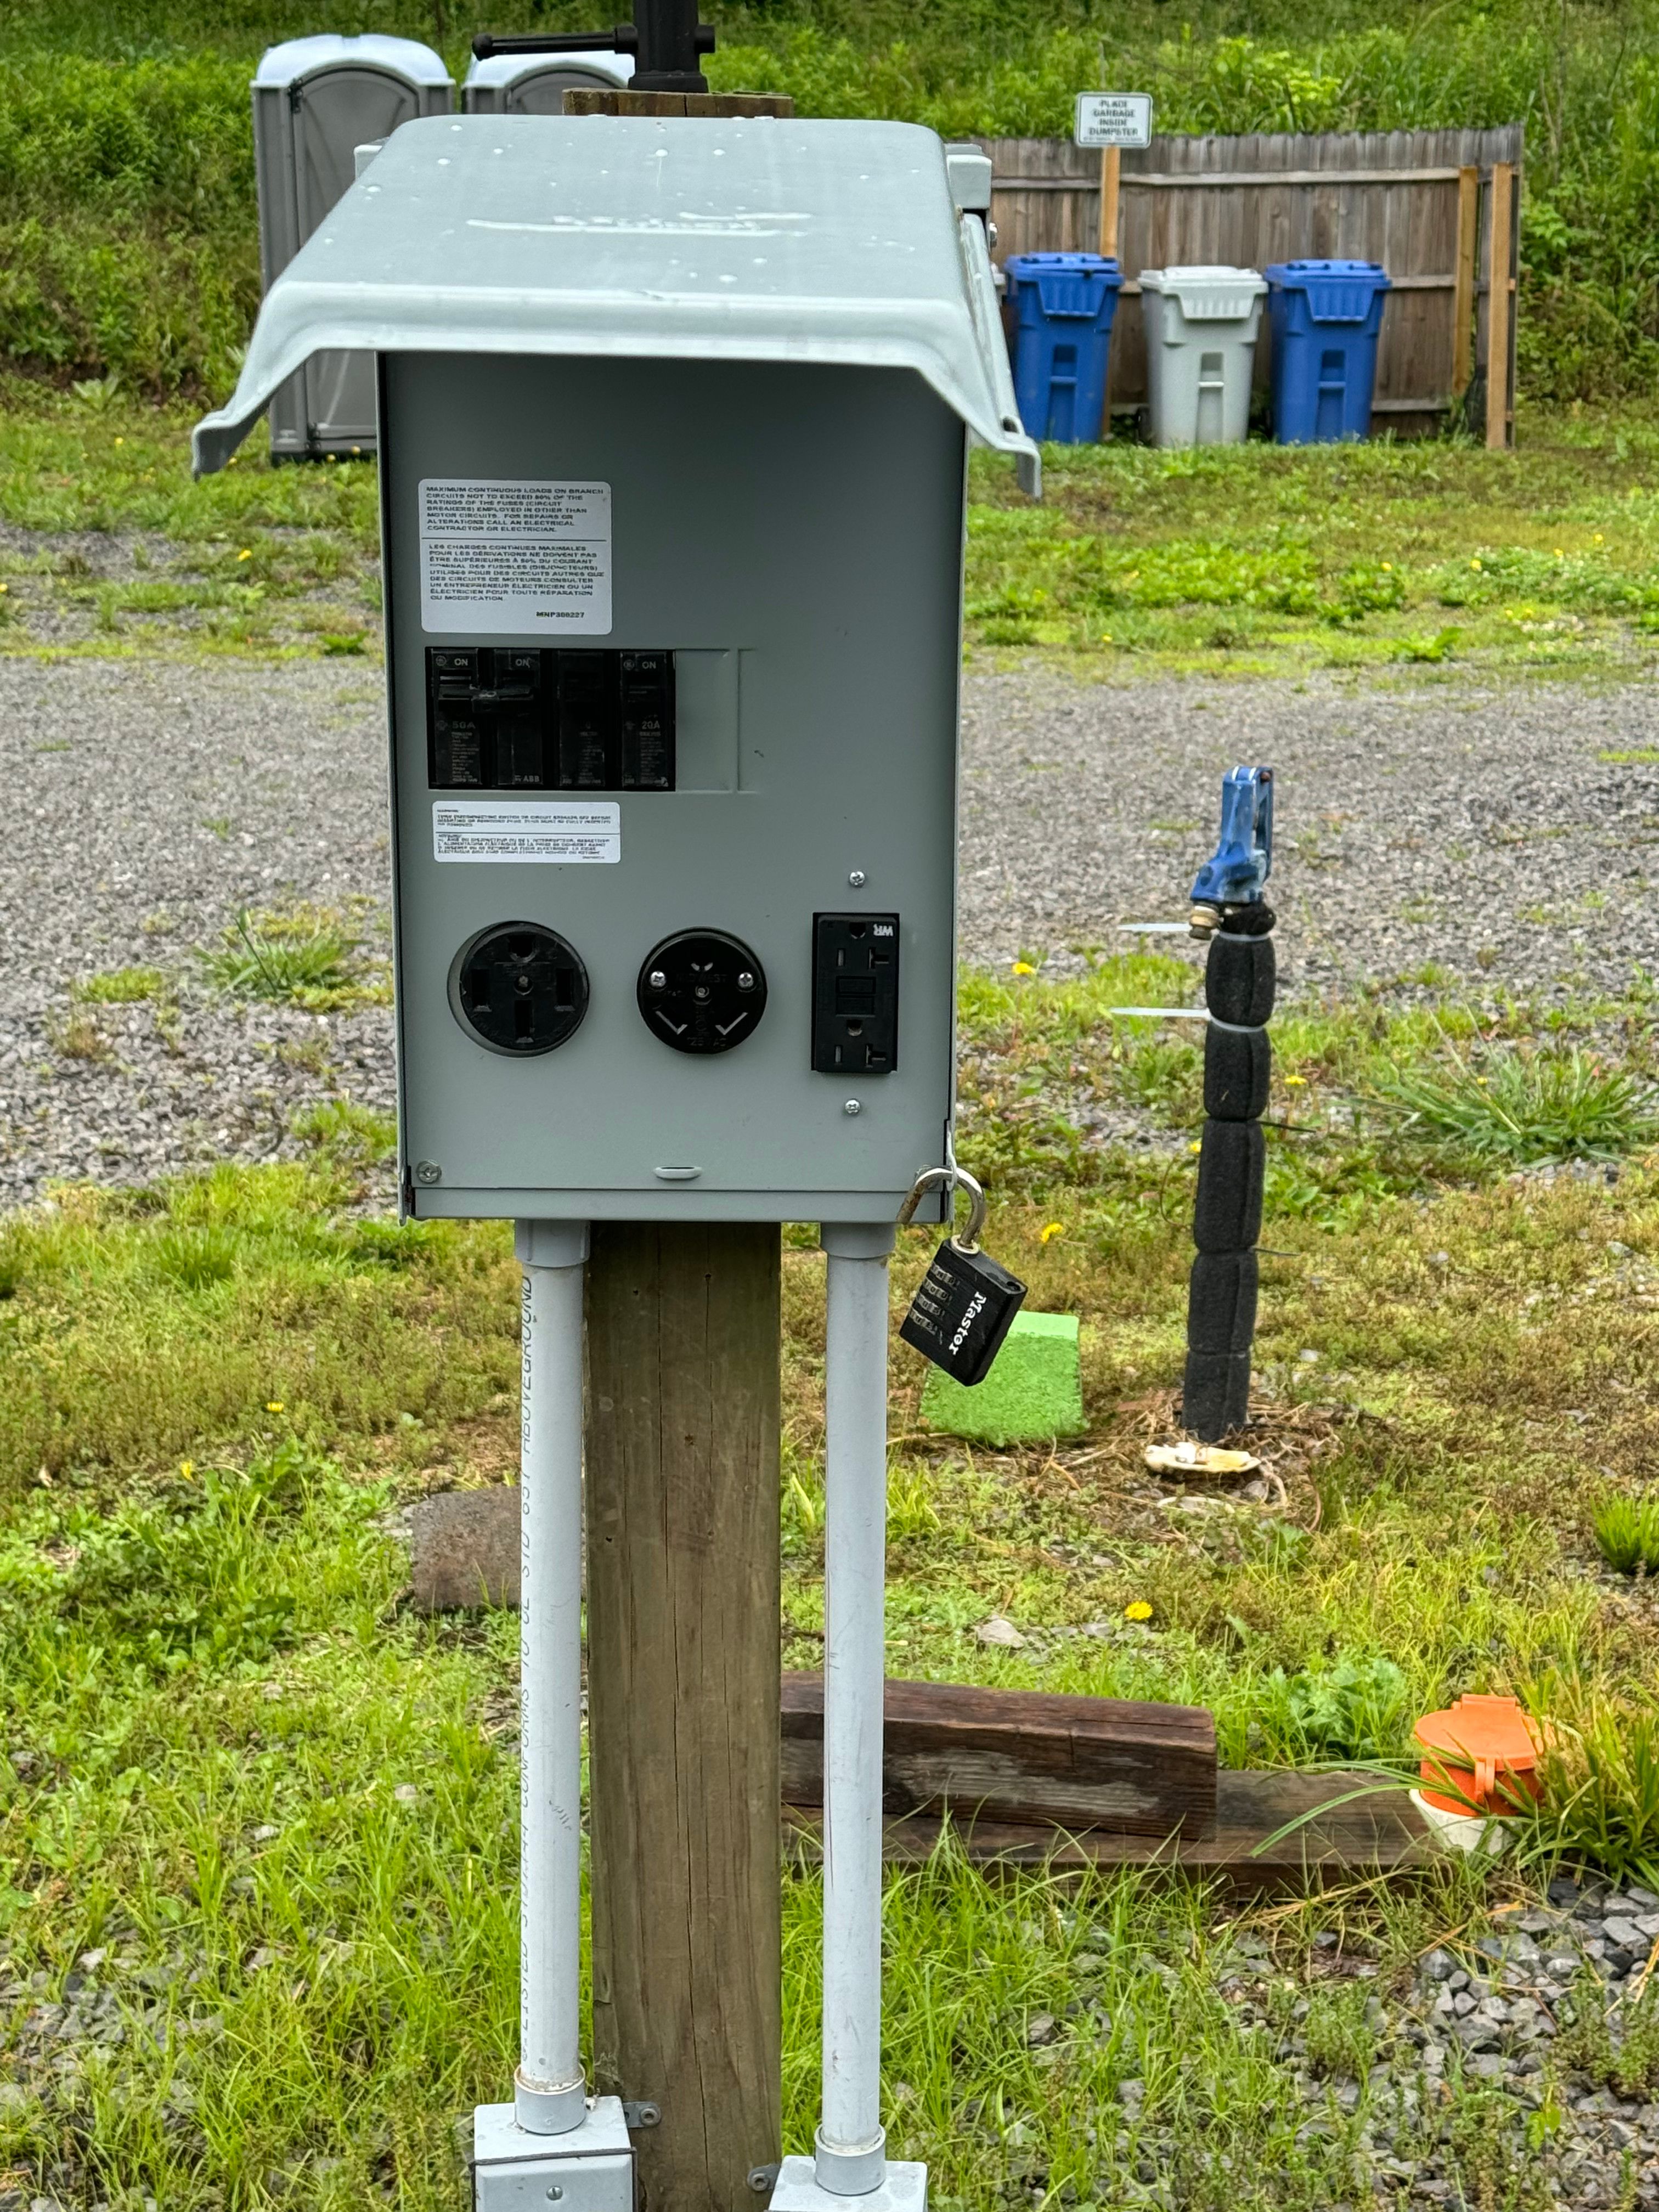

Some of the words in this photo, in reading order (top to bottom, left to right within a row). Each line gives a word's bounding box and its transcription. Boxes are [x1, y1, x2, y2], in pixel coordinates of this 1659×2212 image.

[1093, 109, 1135, 117] GARBAGE
[1089, 127, 1138, 136] DUMPSTER
[454, 658, 469, 666] ON
[515, 659, 529, 667] ON
[641, 661, 657, 669] ON
[641, 720, 661, 730] 20A
[522, 775, 540, 783] ABB
[873, 923, 894, 936] WR
[948, 1291, 987, 1355] Master
